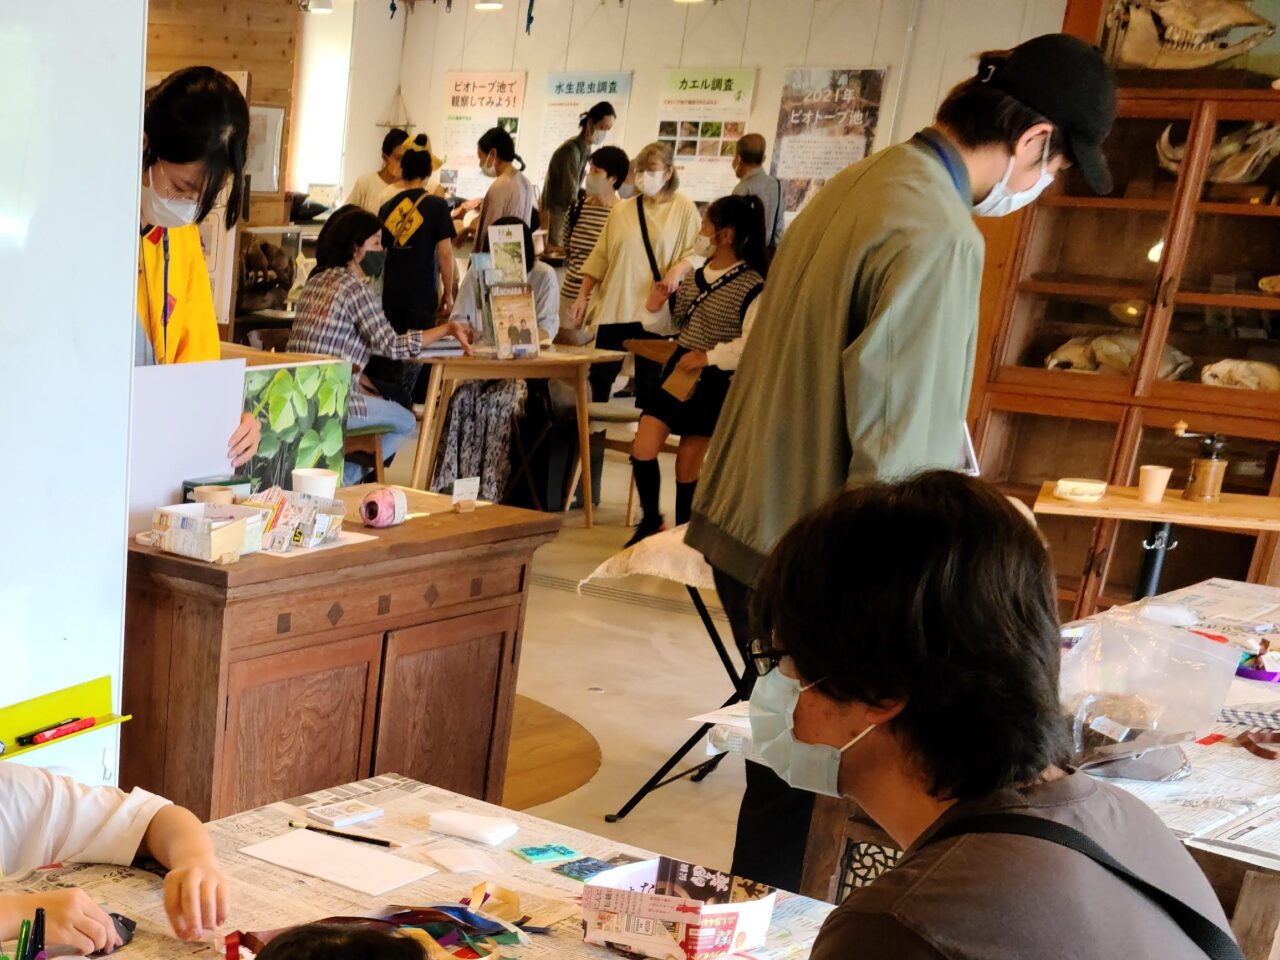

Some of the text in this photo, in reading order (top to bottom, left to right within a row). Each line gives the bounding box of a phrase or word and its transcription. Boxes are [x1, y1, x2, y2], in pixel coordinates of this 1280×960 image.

[454, 80, 517, 93] ビオトープ池で
[554, 80, 619, 94] 水生昆虫調査
[678, 77, 735, 92] カエル調査
[803, 89, 856, 103] 2021年
